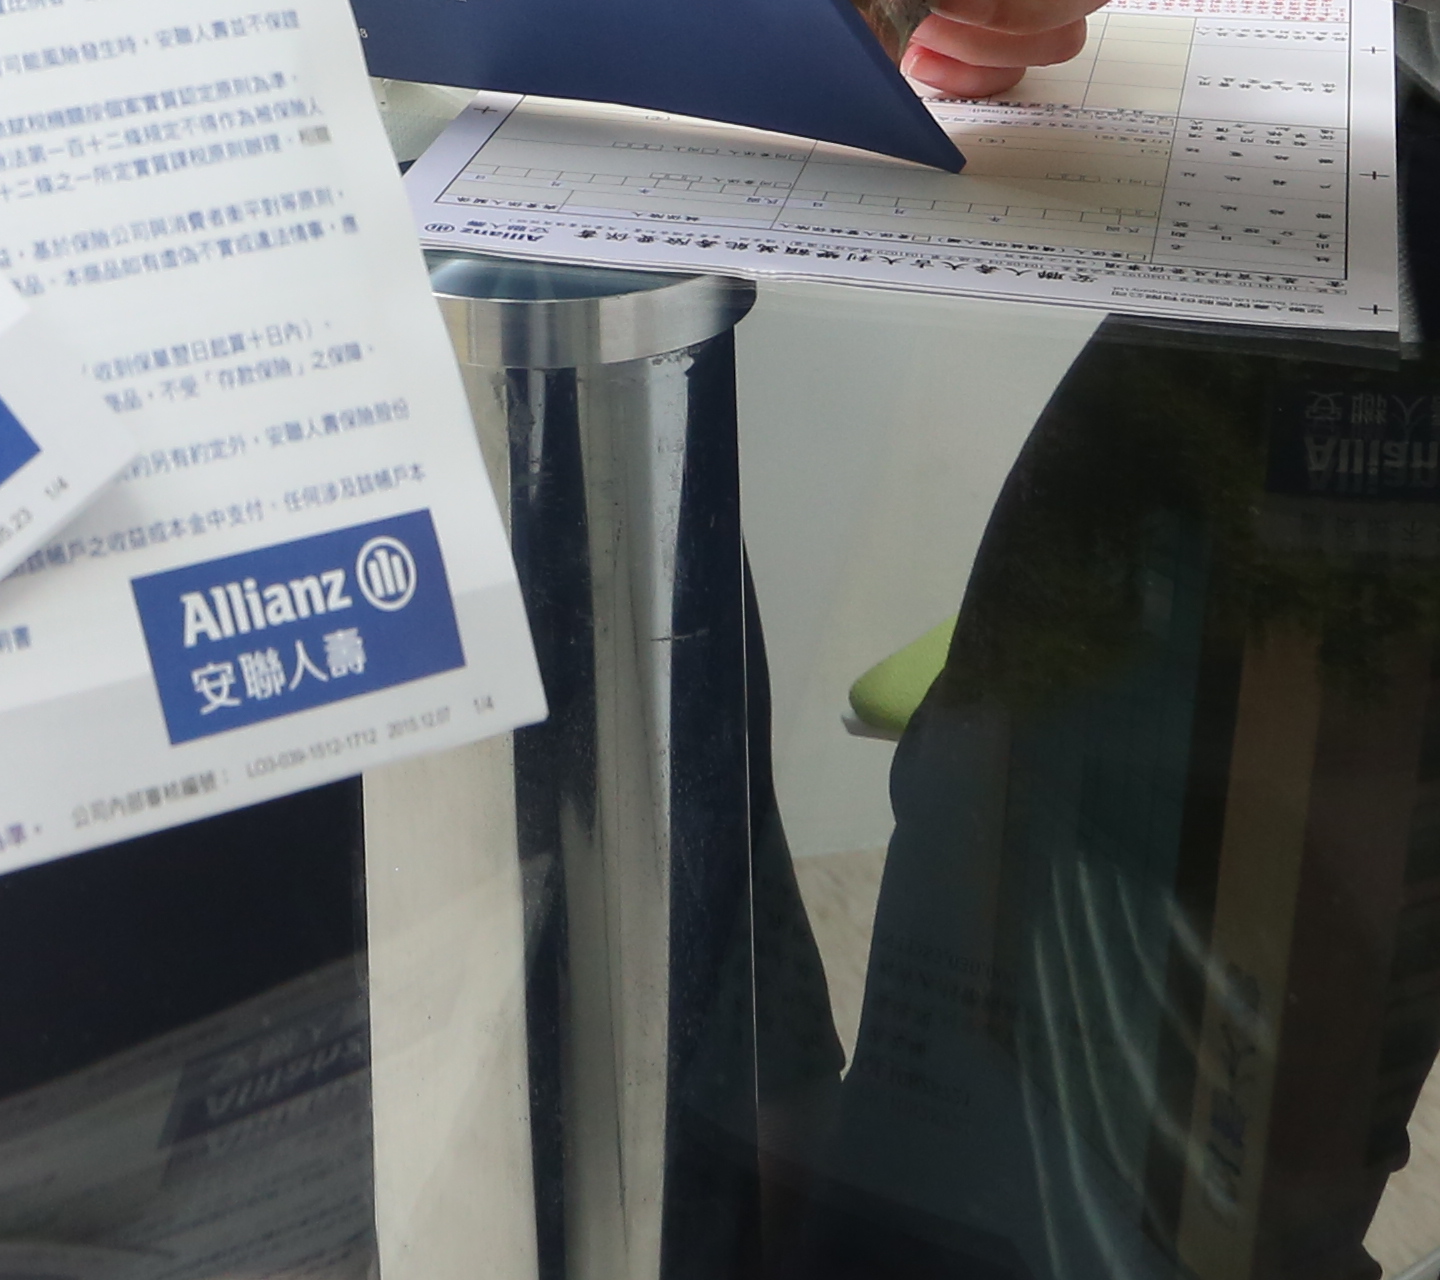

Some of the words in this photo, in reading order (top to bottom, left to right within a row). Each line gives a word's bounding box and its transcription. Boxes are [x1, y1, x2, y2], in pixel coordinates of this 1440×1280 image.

[458, 225, 544, 243] Allianz
[179, 565, 352, 647] Allianz
[192, 625, 366, 718] 安聯人壽
